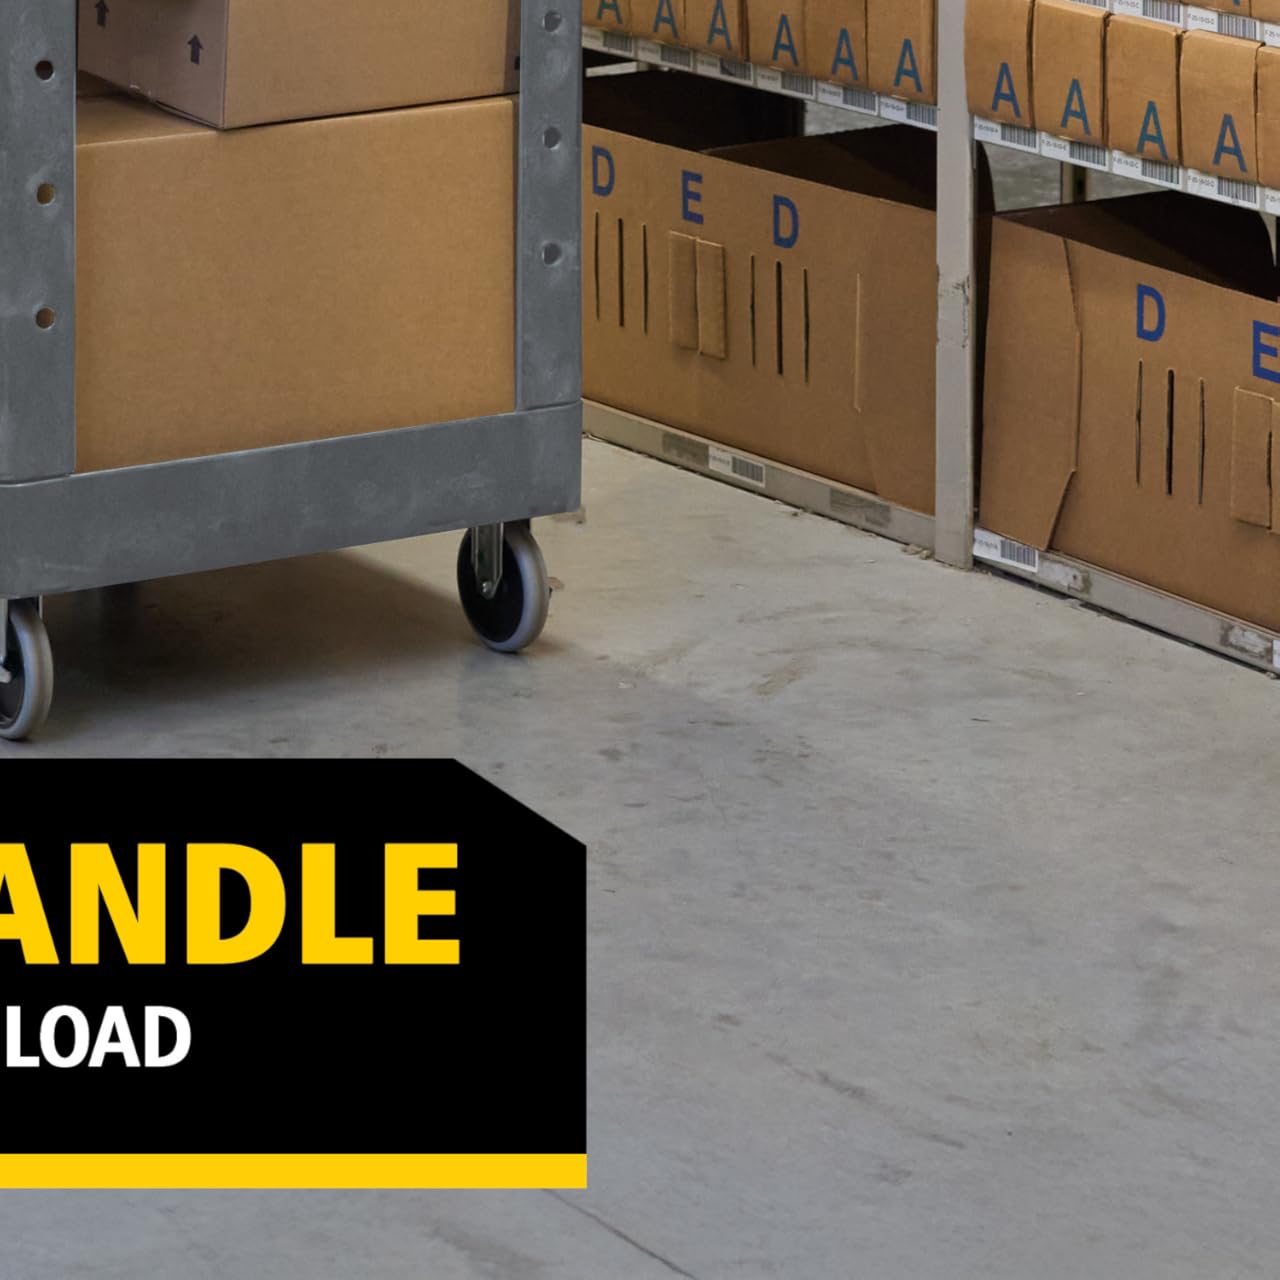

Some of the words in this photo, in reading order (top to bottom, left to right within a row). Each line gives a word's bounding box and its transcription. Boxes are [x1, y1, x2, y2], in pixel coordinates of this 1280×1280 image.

[708, 0, 731, 48] A
[773, 16, 798, 64] A
[895, 40, 922, 92] A
[992, 64, 1021, 117] A
[1062, 80, 1090, 134] A
[1138, 102, 1168, 160] A
[1213, 115, 1246, 172] A
[592, 146, 615, 196] D
[682, 171, 703, 224] E
[773, 196, 799, 248] D
[1137, 285, 1165, 341] D
[1253, 321, 1280, 383] E
